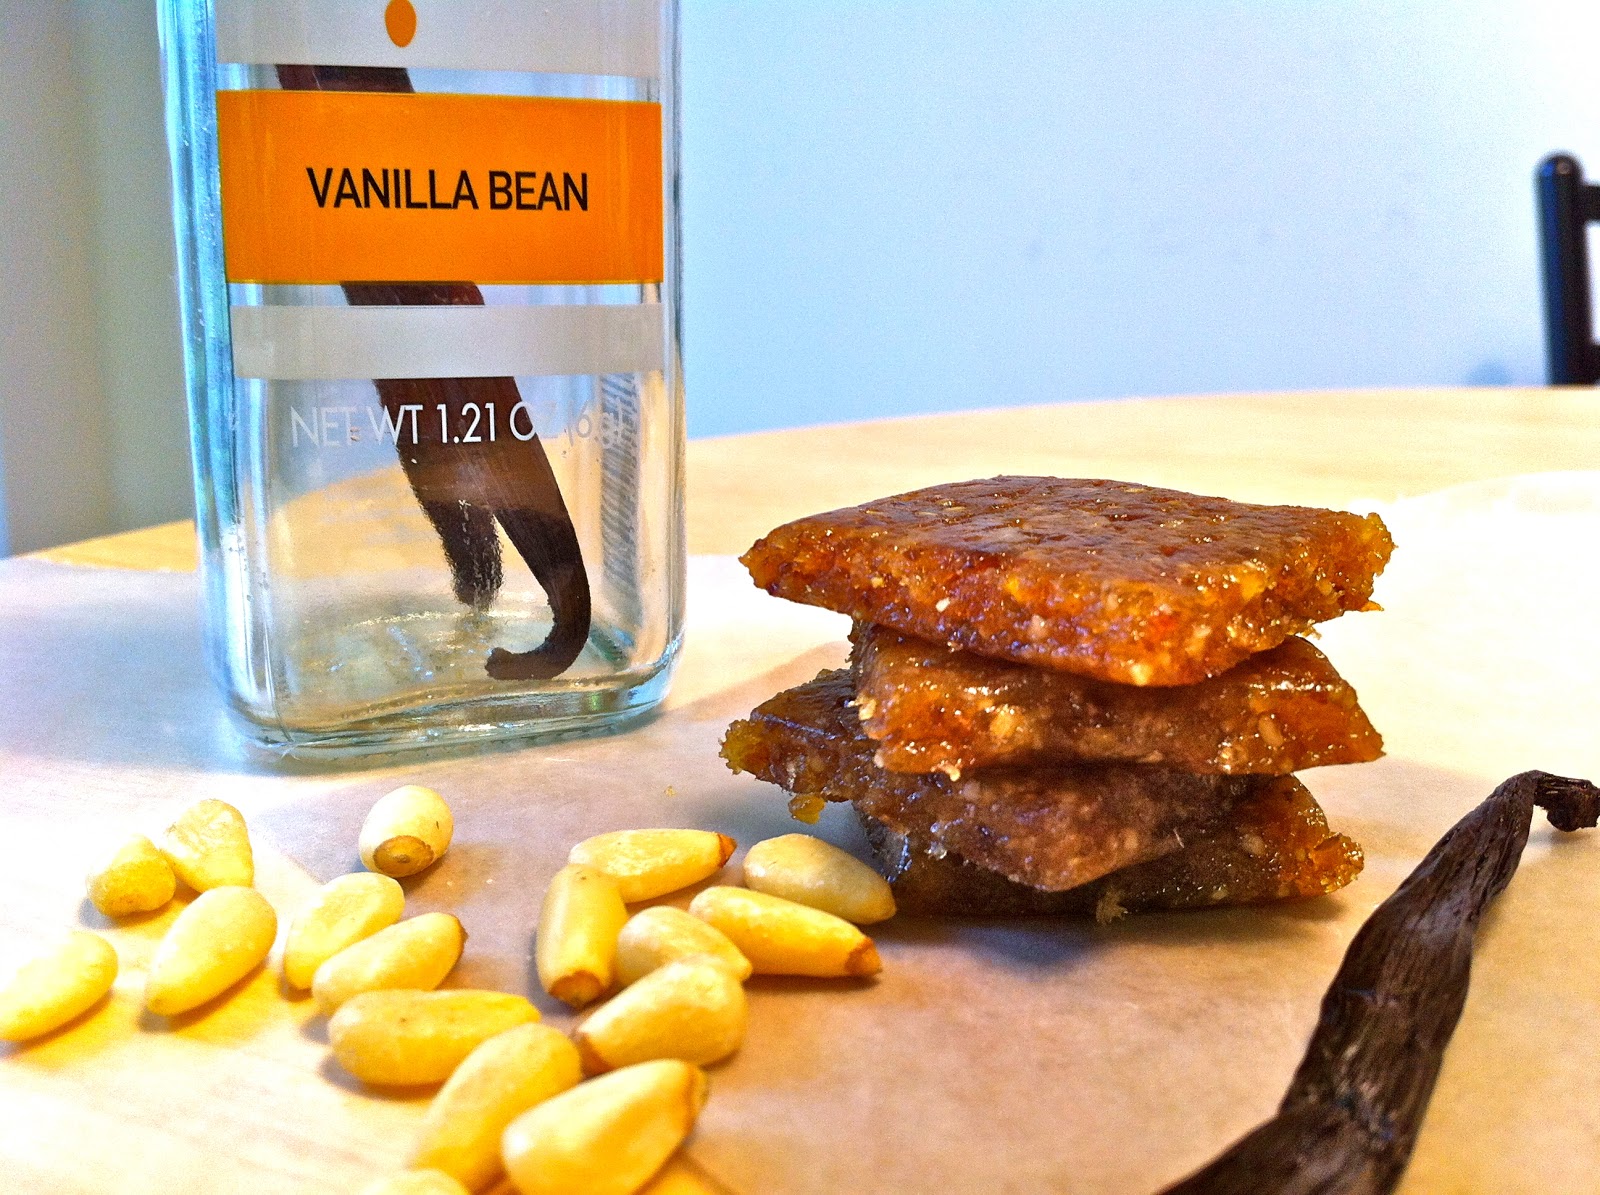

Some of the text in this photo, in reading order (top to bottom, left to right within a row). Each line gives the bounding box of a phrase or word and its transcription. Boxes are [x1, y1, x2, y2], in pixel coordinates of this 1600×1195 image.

[306, 167, 589, 211] VANILLA BEAN
[290, 404, 358, 447] NET
[365, 404, 423, 445] WT
[436, 402, 496, 444] 1.21
